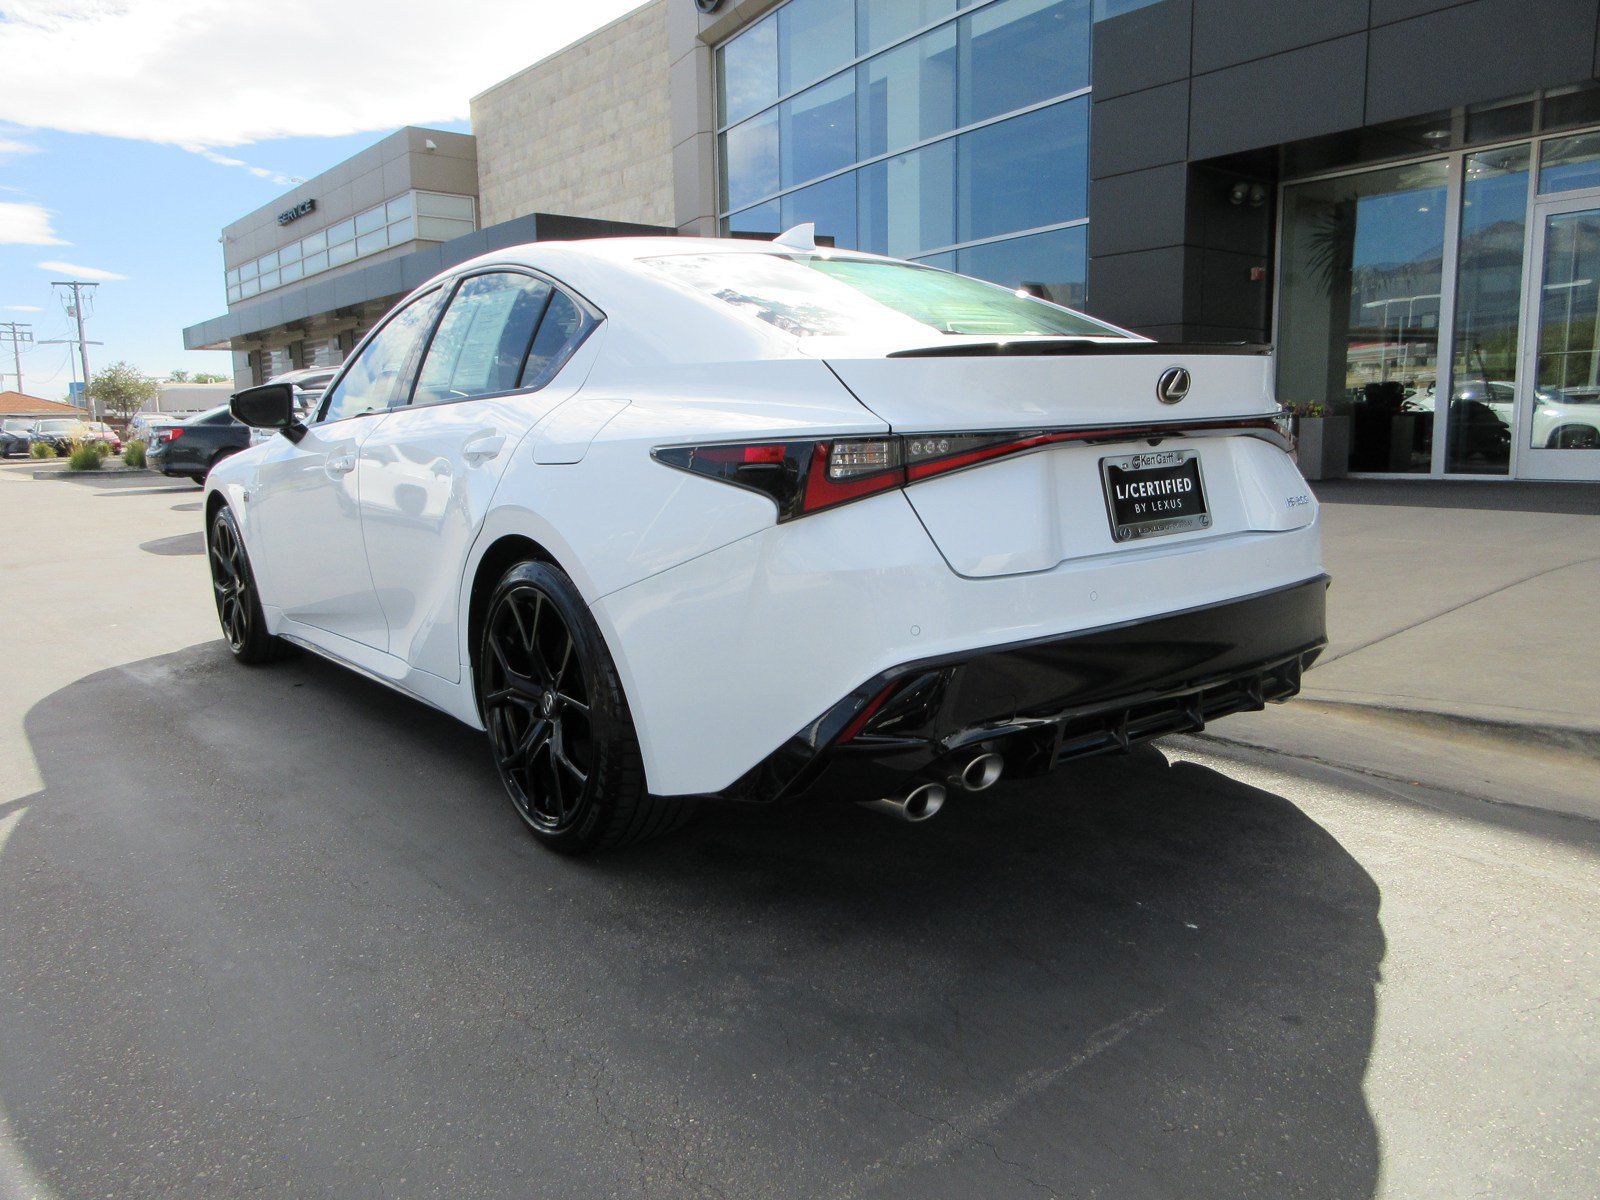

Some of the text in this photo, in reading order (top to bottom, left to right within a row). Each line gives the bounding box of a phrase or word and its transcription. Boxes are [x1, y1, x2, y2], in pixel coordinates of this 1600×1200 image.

[277, 199, 316, 225] SERVICE
[1140, 454, 1155, 466] Ken
[1116, 477, 1192, 499] L/CERTIFIED
[1134, 498, 1182, 514] BY LEXUS
